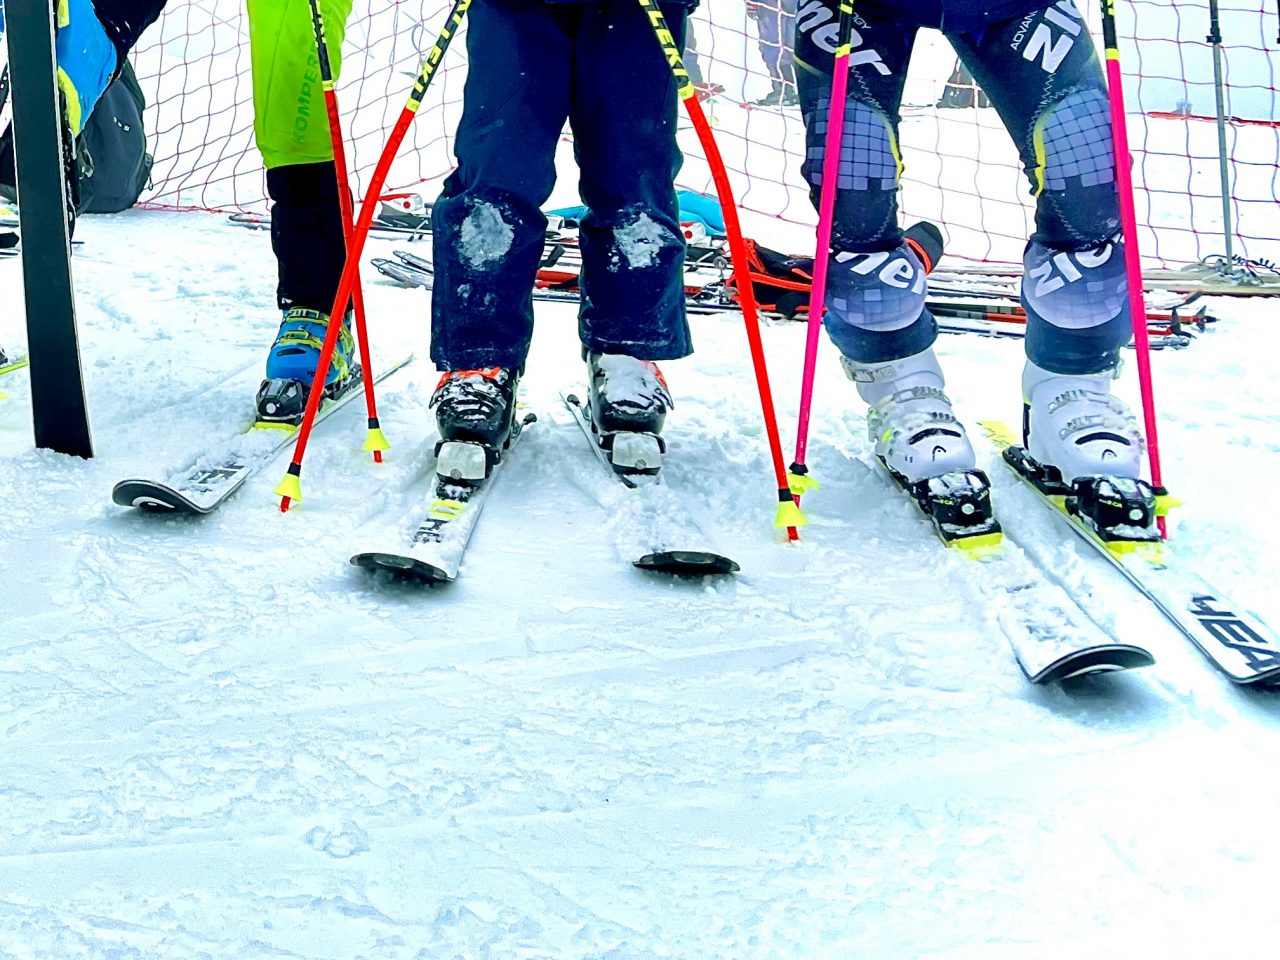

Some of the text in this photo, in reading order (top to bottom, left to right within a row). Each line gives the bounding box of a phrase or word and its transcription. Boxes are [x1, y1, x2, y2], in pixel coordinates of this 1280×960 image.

[647, 10, 689, 76] LEKI
[291, 40, 320, 144] KOMPER
[1189, 594, 1280, 674] HEA
